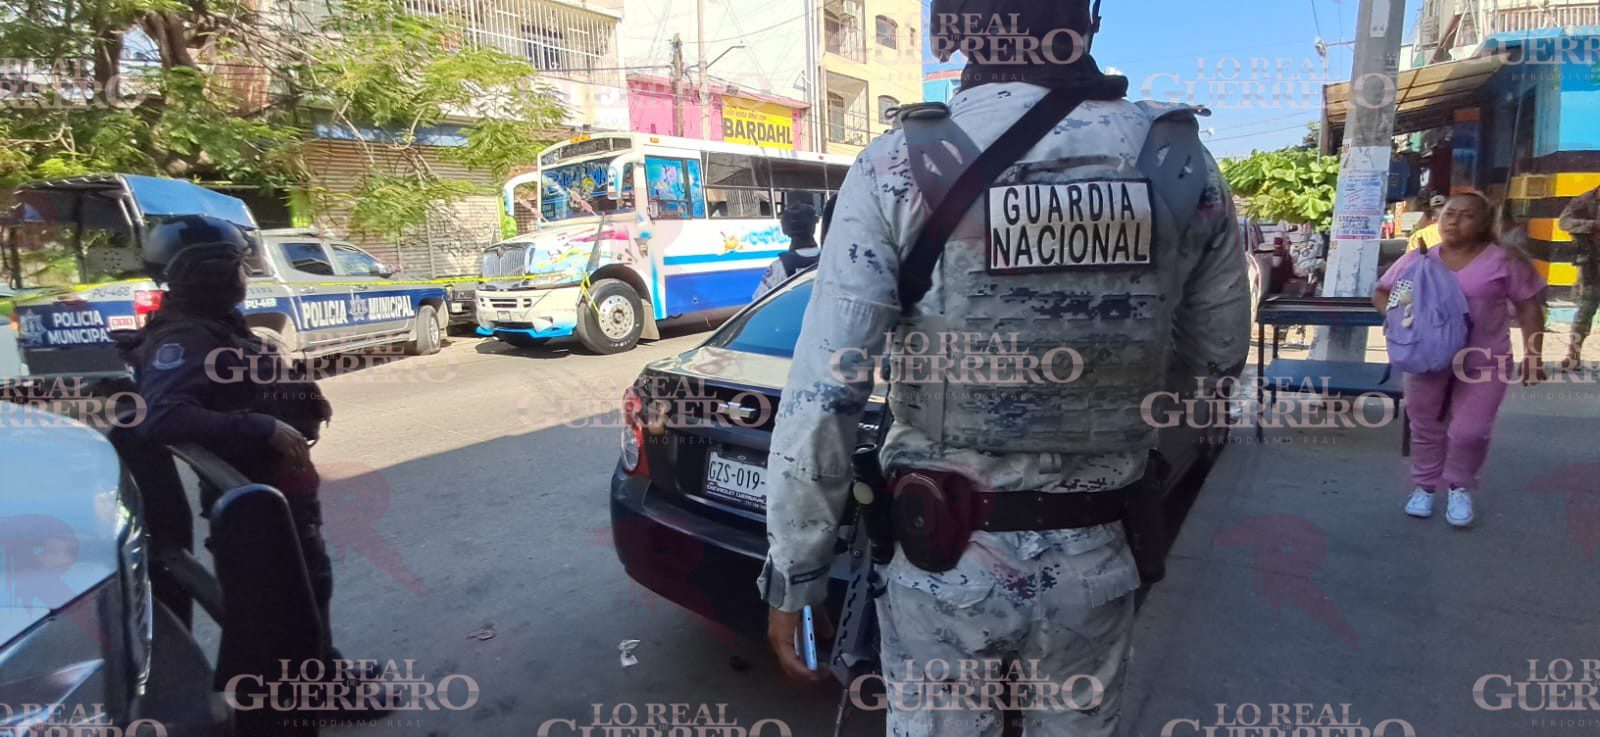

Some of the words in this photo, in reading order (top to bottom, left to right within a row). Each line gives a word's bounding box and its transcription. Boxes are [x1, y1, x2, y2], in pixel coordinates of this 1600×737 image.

[723, 117, 793, 146] BARDAHL
[1003, 182, 1136, 226] GUARDIA
[992, 222, 1149, 268] NACIONAL
[52, 309, 104, 329] POLICIA
[304, 300, 348, 330] POLICIA
[368, 294, 415, 321] MUNICIPAL
